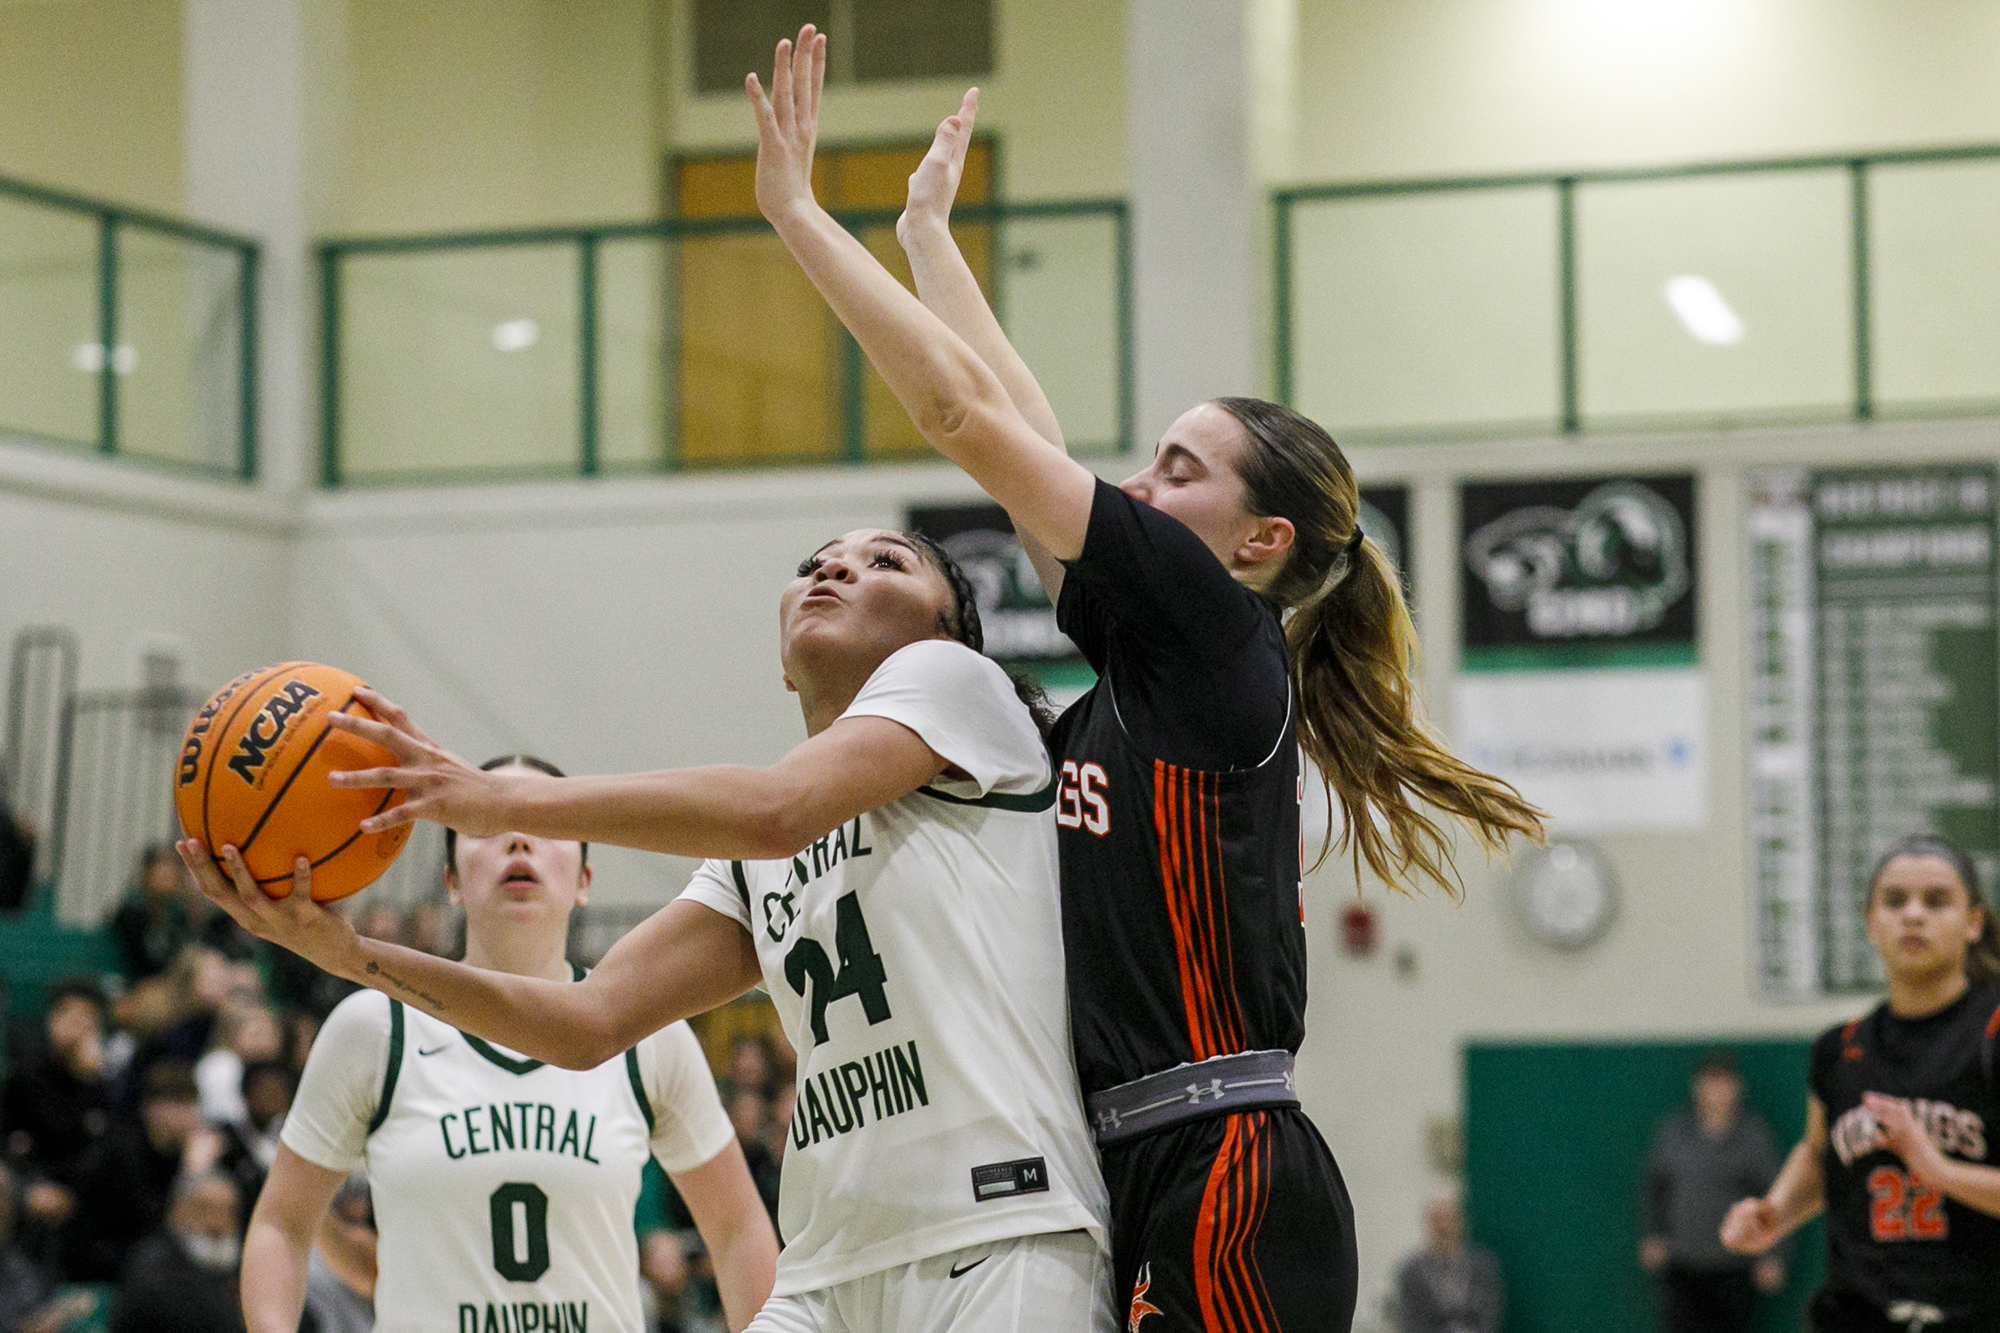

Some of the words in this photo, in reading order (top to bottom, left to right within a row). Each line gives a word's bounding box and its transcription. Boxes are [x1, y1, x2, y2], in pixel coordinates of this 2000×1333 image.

[227, 680, 321, 787] NCAA
[784, 889, 892, 1047] 24
[440, 1102, 600, 1165] CENTRAL
[792, 1040, 929, 1151] DAUPHIN
[1023, 1167, 1038, 1182] M
[1868, 1167, 1948, 1239] 22
[489, 1182, 550, 1282] 0
